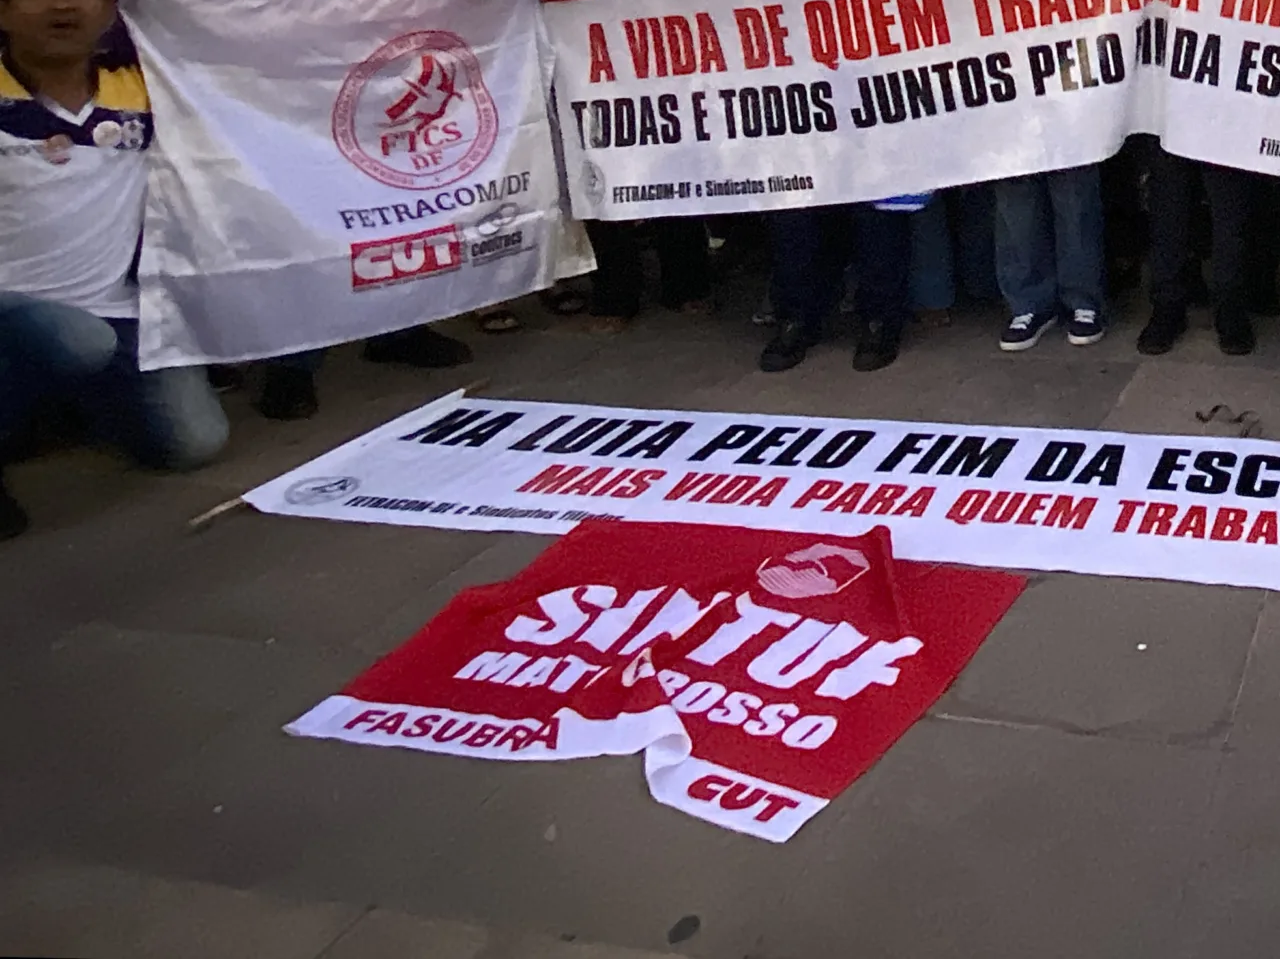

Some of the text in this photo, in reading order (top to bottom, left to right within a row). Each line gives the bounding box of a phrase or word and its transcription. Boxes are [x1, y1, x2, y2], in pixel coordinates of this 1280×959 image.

[589, 23, 616, 83] A
[622, 12, 728, 79] VIDA
[734, 4, 794, 71] DE
[571, 93, 682, 151] TODAS
[691, 91, 711, 142] E
[719, 81, 838, 140] TODOS
[850, 51, 1017, 129] JUNTOS
[1027, 33, 1126, 97] PELO
[1170, 27, 1221, 87] DA
[410, 151, 443, 171] DF
[338, 171, 531, 230] FETRACOM/DF
[613, 174, 814, 203] FETRACOM-DF e Sindicatos filiados
[353, 238, 455, 280] CUT
[400, 408, 507, 448] NA
[516, 414, 664, 459] LUTA
[690, 423, 877, 471] PELO
[880, 431, 1014, 479] FIM
[1024, 440, 1126, 487] DA
[454, 506, 464, 515] e
[516, 464, 665, 500] MAIS
[667, 474, 788, 508] VIDA
[794, 480, 938, 517] PARA
[946, 489, 1097, 531] QUEM
[343, 709, 560, 752] FASUBRA
[687, 775, 799, 823] CUT
